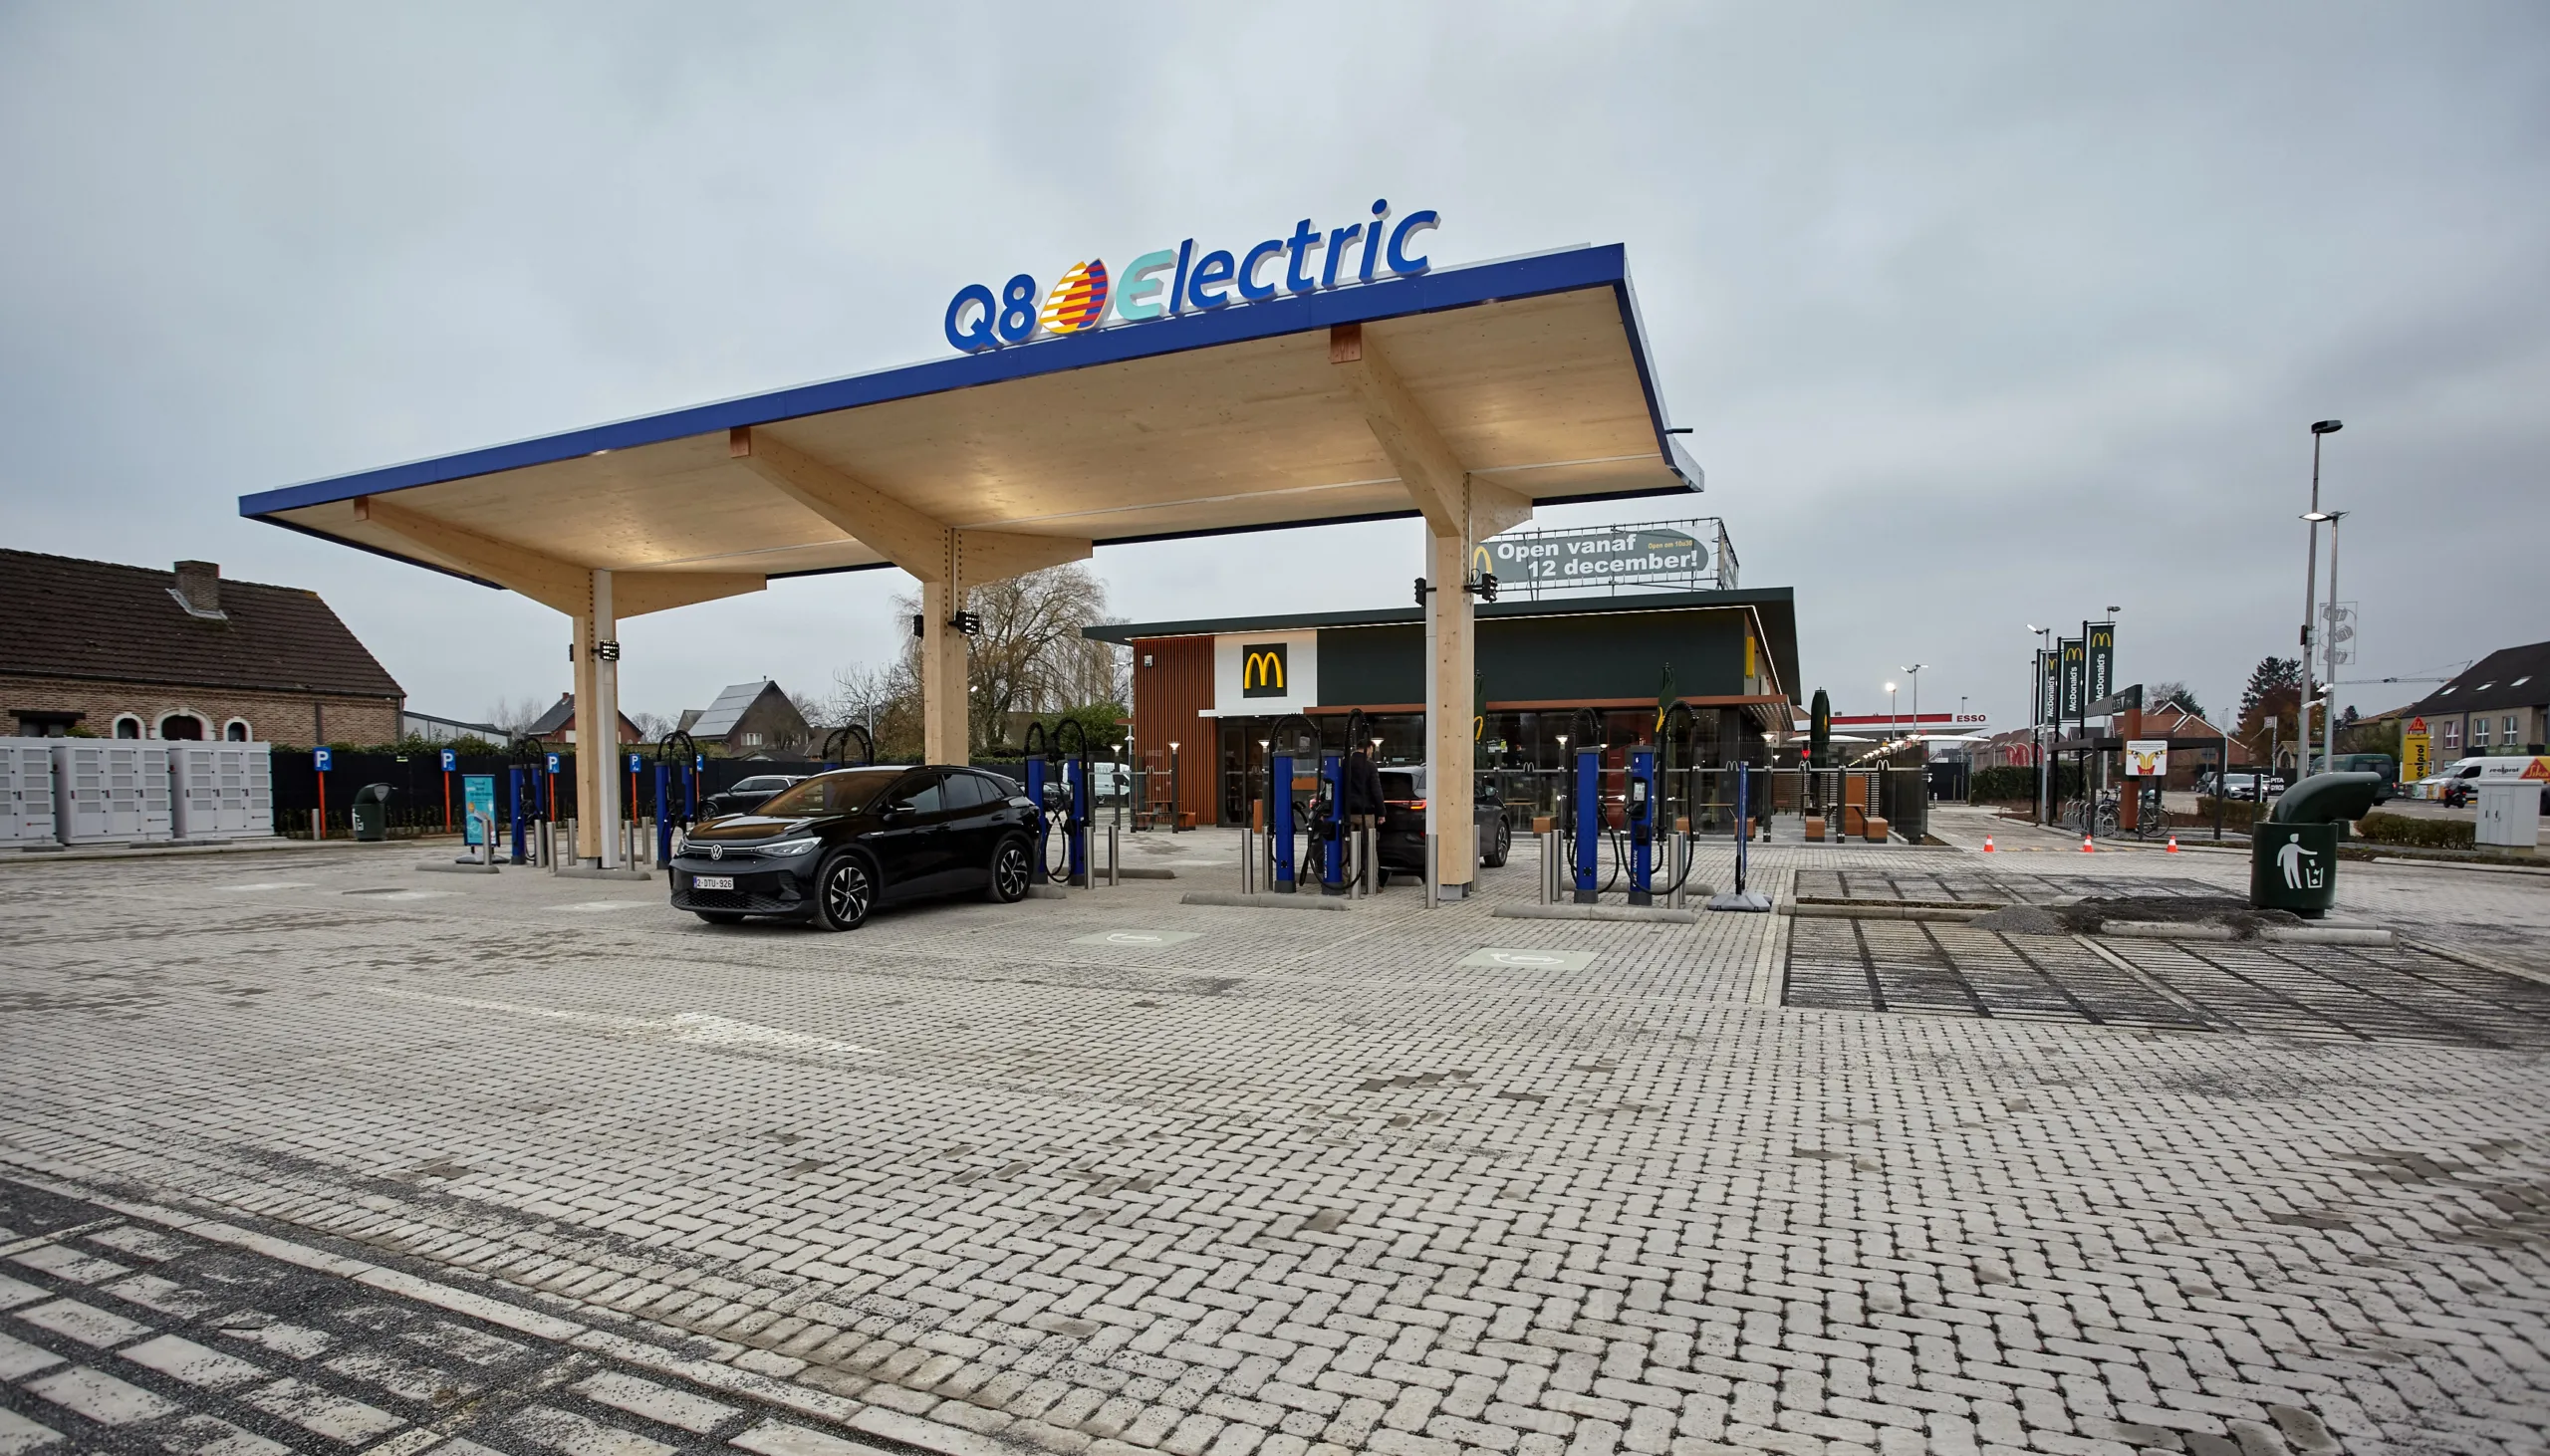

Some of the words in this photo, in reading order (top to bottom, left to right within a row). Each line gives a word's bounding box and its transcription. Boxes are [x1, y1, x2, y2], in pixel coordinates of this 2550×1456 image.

[944, 273, 1040, 355] Q8
[1115, 198, 1441, 321] Electric
[1497, 542, 1559, 563] Open
[1567, 534, 1638, 556] vanaf
[1648, 542, 1663, 551] Open
[1675, 539, 1693, 548] 10u30
[1528, 560, 1557, 578] 12
[1564, 550, 1698, 576] december!
[2069, 666, 2078, 712] McDonald's
[2095, 653, 2106, 702] McDonald's
[2047, 675, 2056, 717] McDonald's
[316, 750, 329, 768] P
[442, 752, 453, 768] P
[549, 756, 558, 770] P
[632, 755, 638, 765] P
[2415, 744, 2425, 778] ealprof
[2526, 764, 2549, 777] Sika
[697, 878, 733, 888] 2-DTU-926
